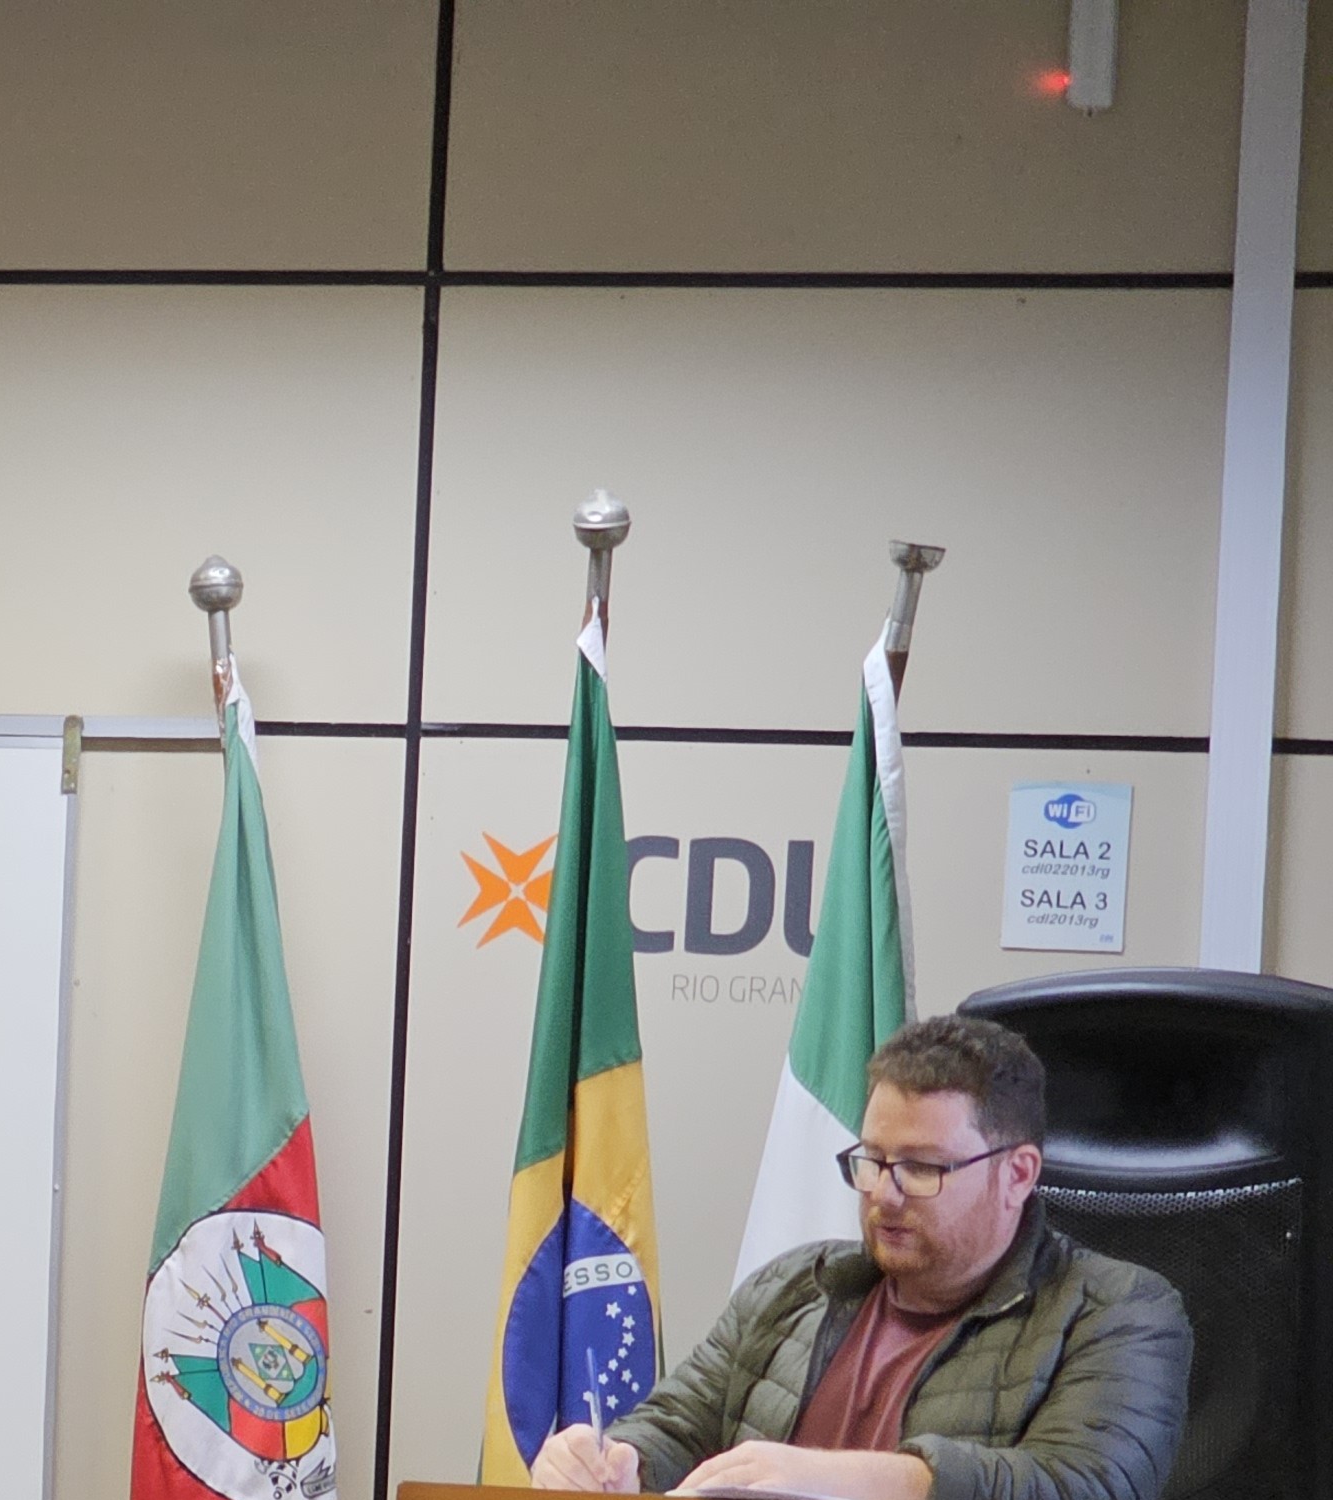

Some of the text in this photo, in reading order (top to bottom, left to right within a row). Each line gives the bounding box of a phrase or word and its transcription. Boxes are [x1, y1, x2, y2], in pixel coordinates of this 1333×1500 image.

[1023, 839, 1112, 860] SALA 2
[626, 835, 815, 958] CDL
[1020, 889, 1108, 911] SALA 3
[671, 973, 804, 1004] RIO GRAN
